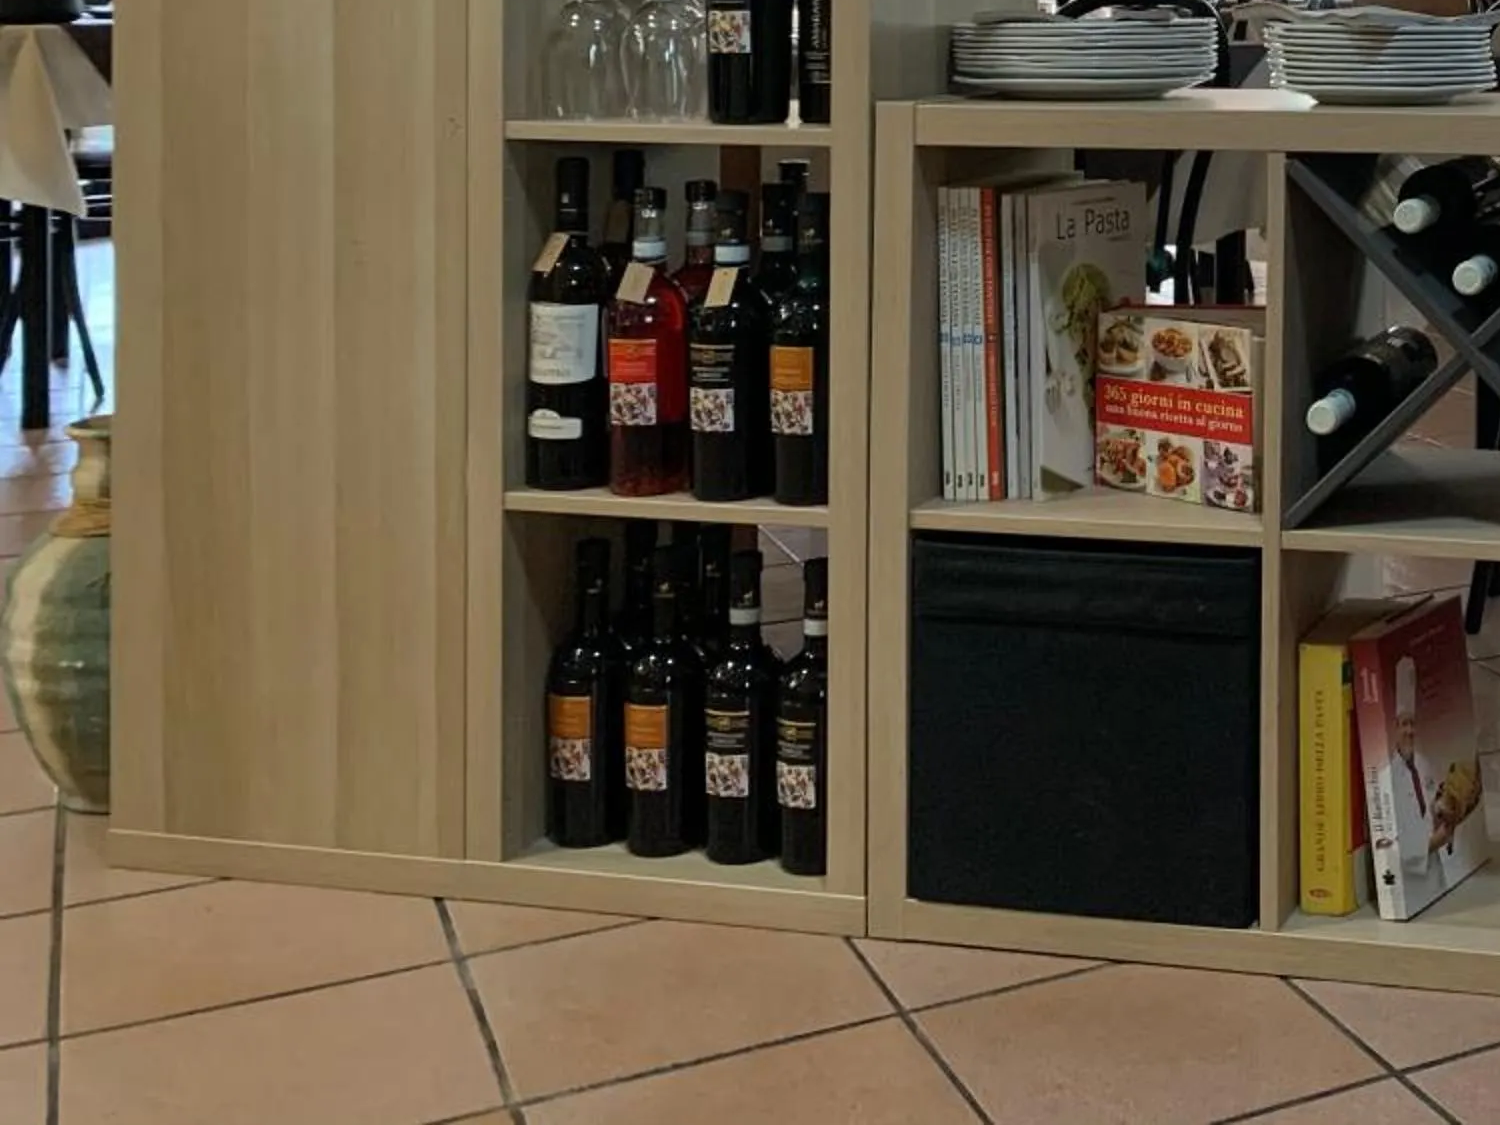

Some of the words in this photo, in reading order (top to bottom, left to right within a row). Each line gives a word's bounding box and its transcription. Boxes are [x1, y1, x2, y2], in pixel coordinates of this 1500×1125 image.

[1056, 213, 1077, 241] La
[1085, 207, 1131, 235] Pasta
[1127, 405, 1159, 420] buona
[1160, 410, 1194, 426] ricetta
[1207, 417, 1243, 433] giorno
[1130, 387, 1174, 410] giorni
[1177, 393, 1191, 411] in
[1195, 399, 1244, 420] cucina
